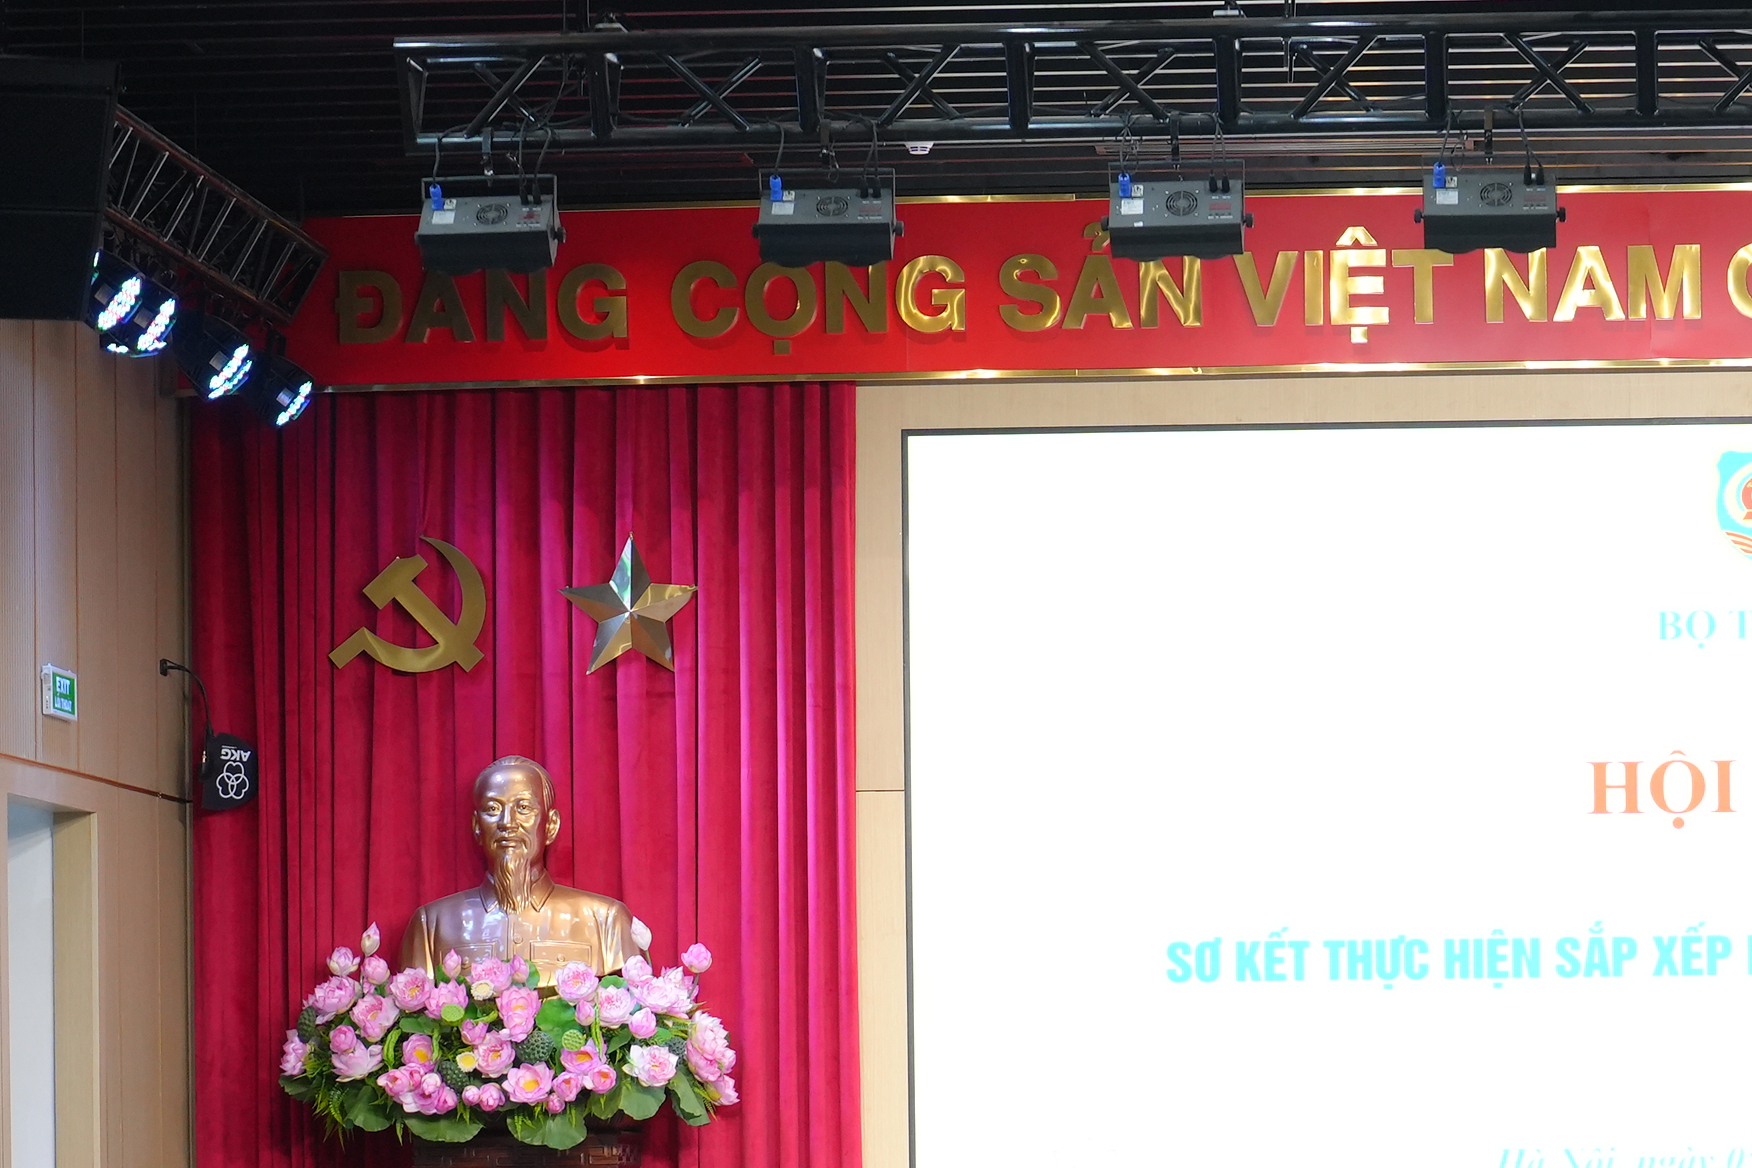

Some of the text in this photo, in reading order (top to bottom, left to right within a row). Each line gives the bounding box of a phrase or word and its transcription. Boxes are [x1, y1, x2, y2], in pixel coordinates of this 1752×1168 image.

[998, 222, 1202, 332] SẢN
[1234, 226, 1454, 343] VIỆT
[1484, 243, 1702, 323] NAM
[56, 675, 71, 695] EXIT
[220, 748, 251, 761] AKG
[1587, 750, 1737, 829] HỘI
[1167, 937, 1222, 983] SƠ
[1236, 927, 1310, 982] KẾT
[1324, 935, 1429, 990] THỰC
[1445, 929, 1540, 988] HIỆN
[1556, 921, 1637, 978] SẮP
[1653, 922, 1732, 976] XẾP
